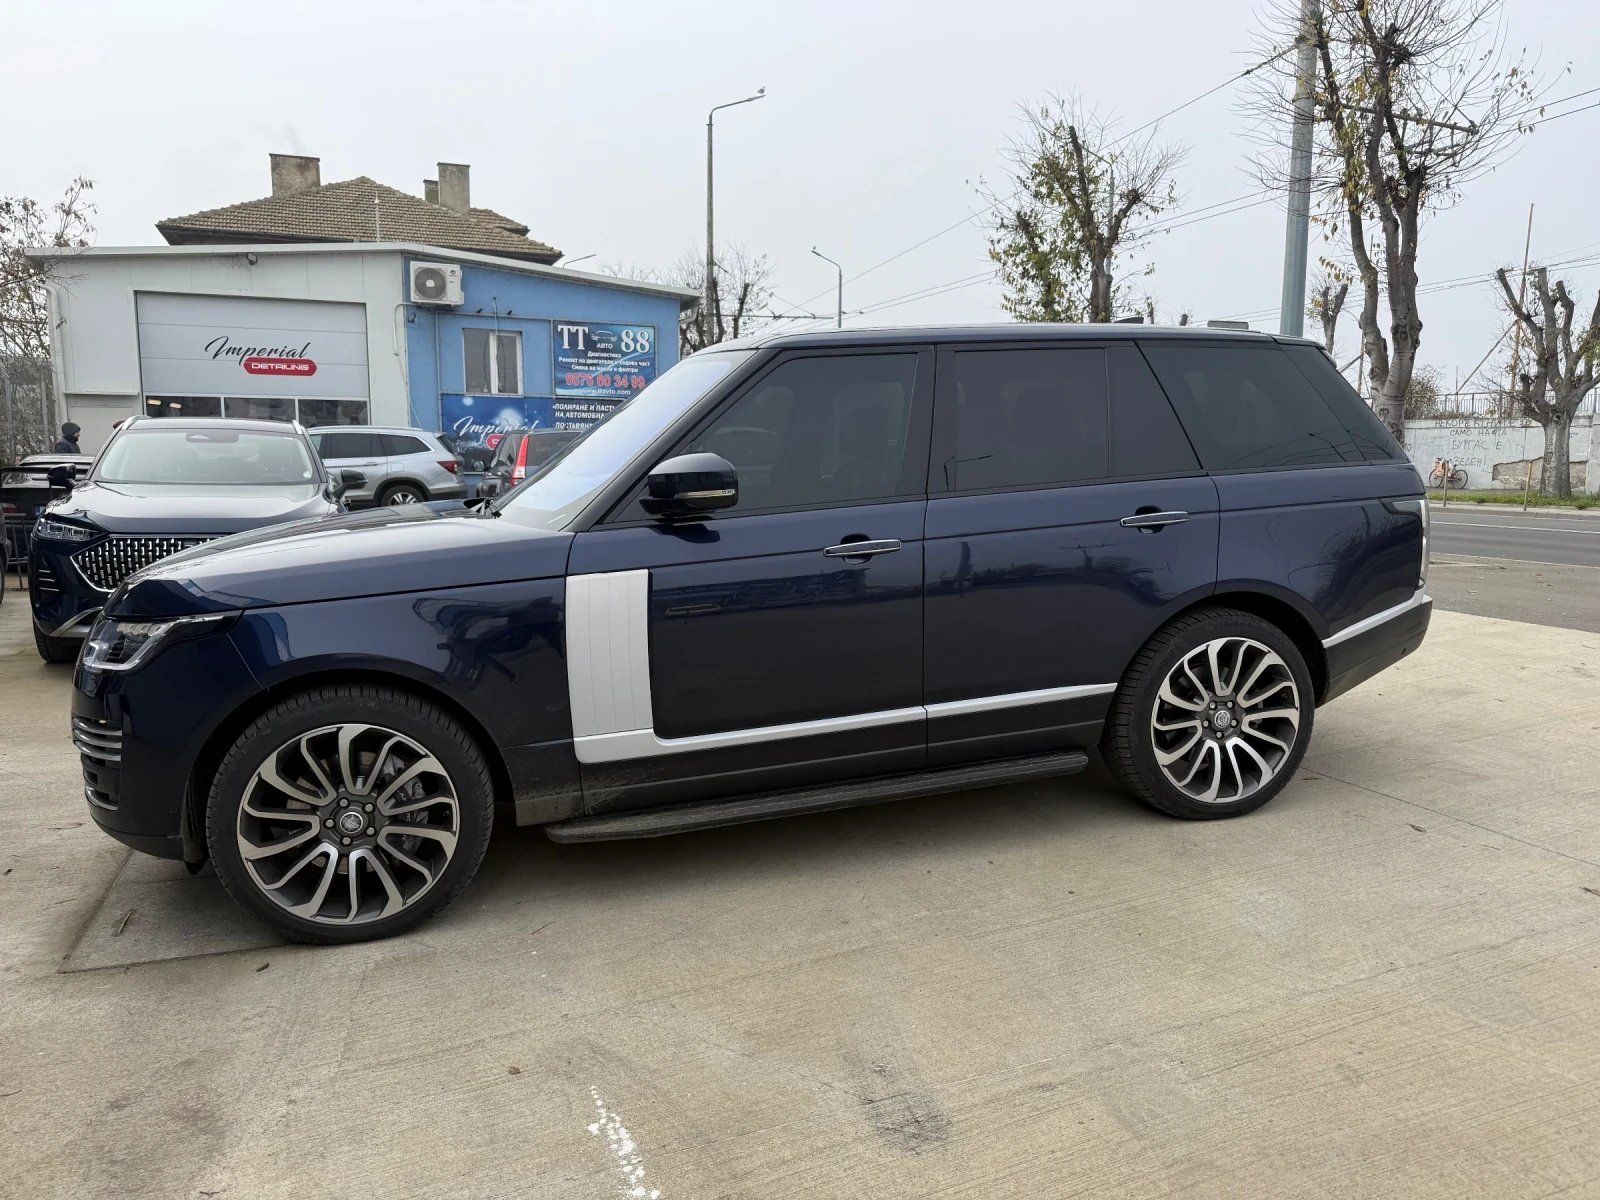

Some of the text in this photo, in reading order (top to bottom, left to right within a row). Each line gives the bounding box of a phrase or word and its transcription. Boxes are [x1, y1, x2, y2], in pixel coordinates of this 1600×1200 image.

[621, 329, 650, 353] 88
[204, 335, 311, 366] Imperial
[251, 362, 310, 371] DETAILING
[565, 372, 646, 389] 0876 60 34 99
[580, 388, 631, 396] www.ttavto.com
[565, 412, 606, 420] АВТОМОБИЛ
[1450, 429, 1472, 437] САМО
[1452, 439, 1488, 450] БУРГАС
